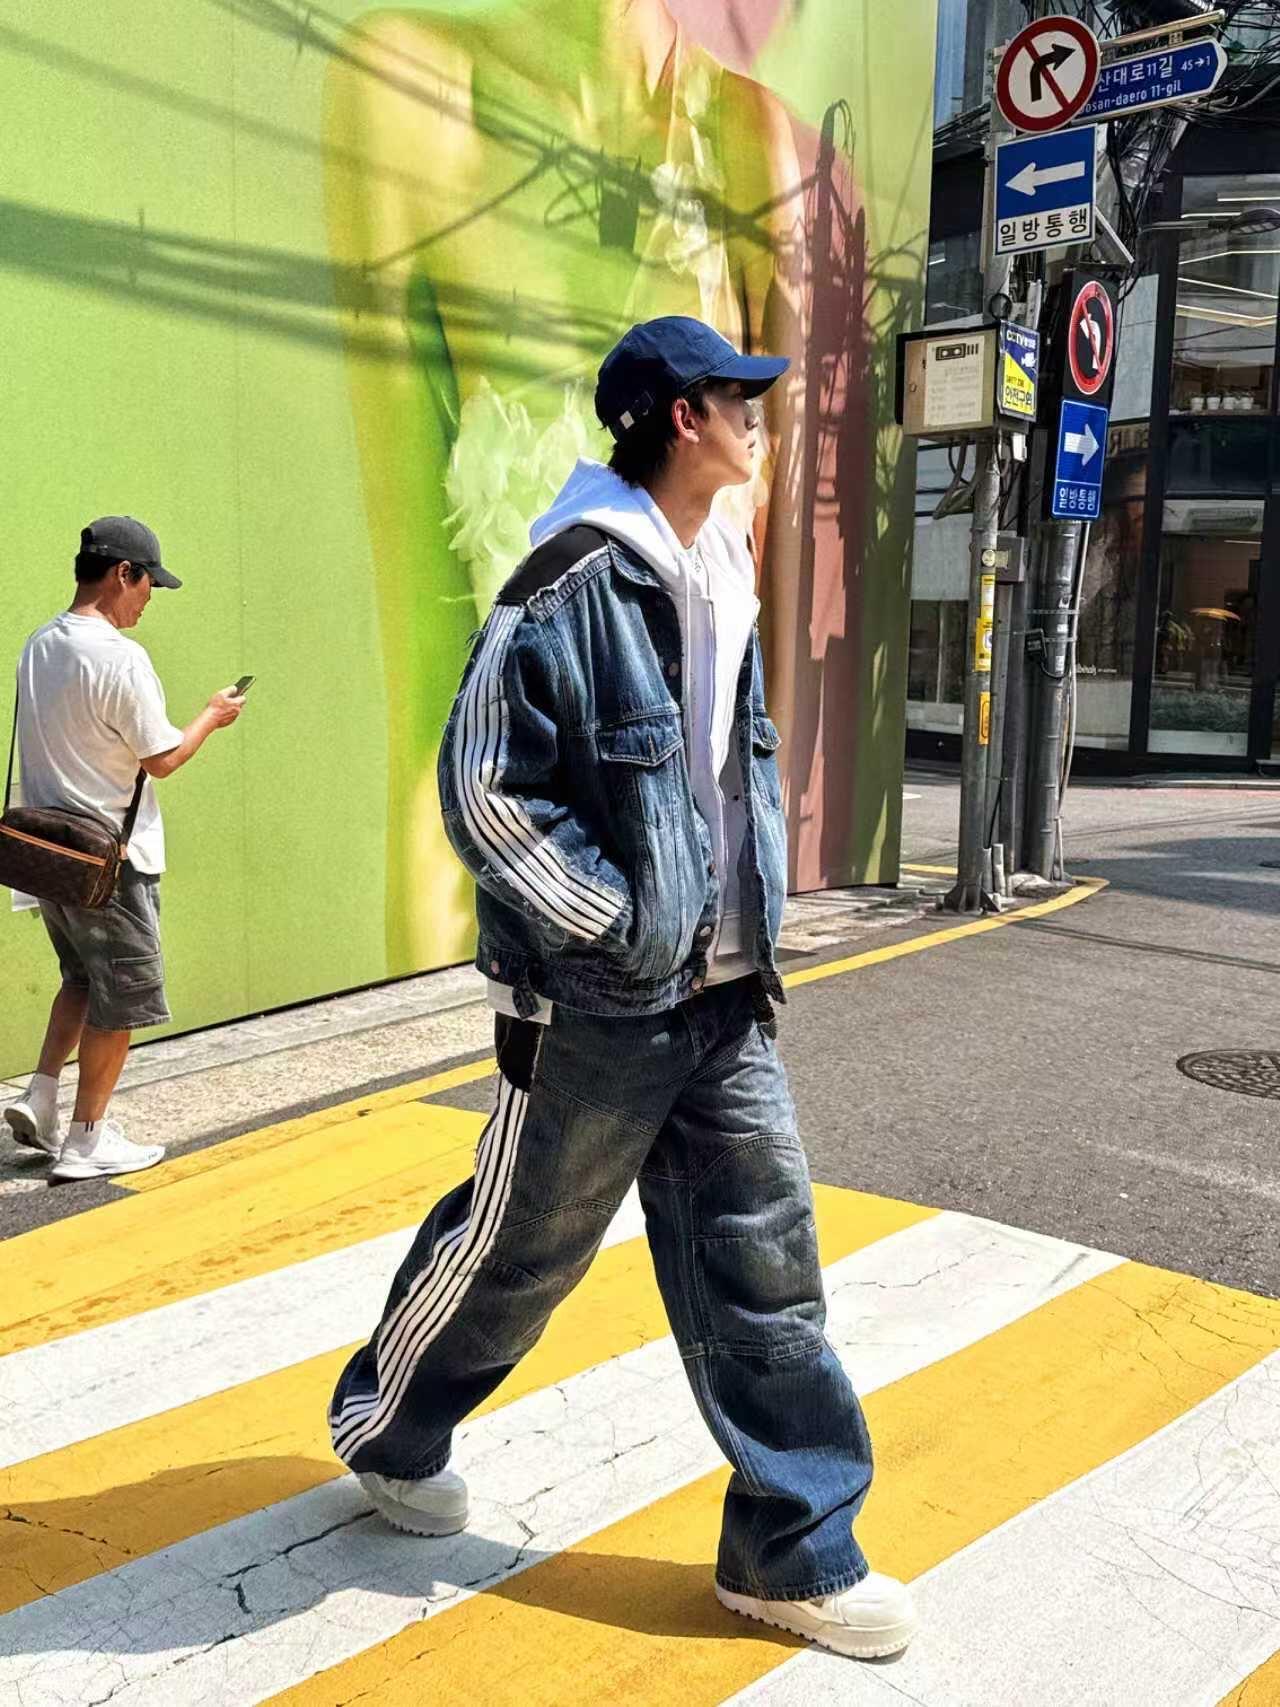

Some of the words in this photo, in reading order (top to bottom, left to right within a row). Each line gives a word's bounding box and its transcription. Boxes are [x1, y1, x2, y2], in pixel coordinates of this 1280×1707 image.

[1151, 79, 1182, 98] 11-gil
[1000, 208, 1087, 246] 일방통행
[1056, 487, 1097, 511] 일방통행
